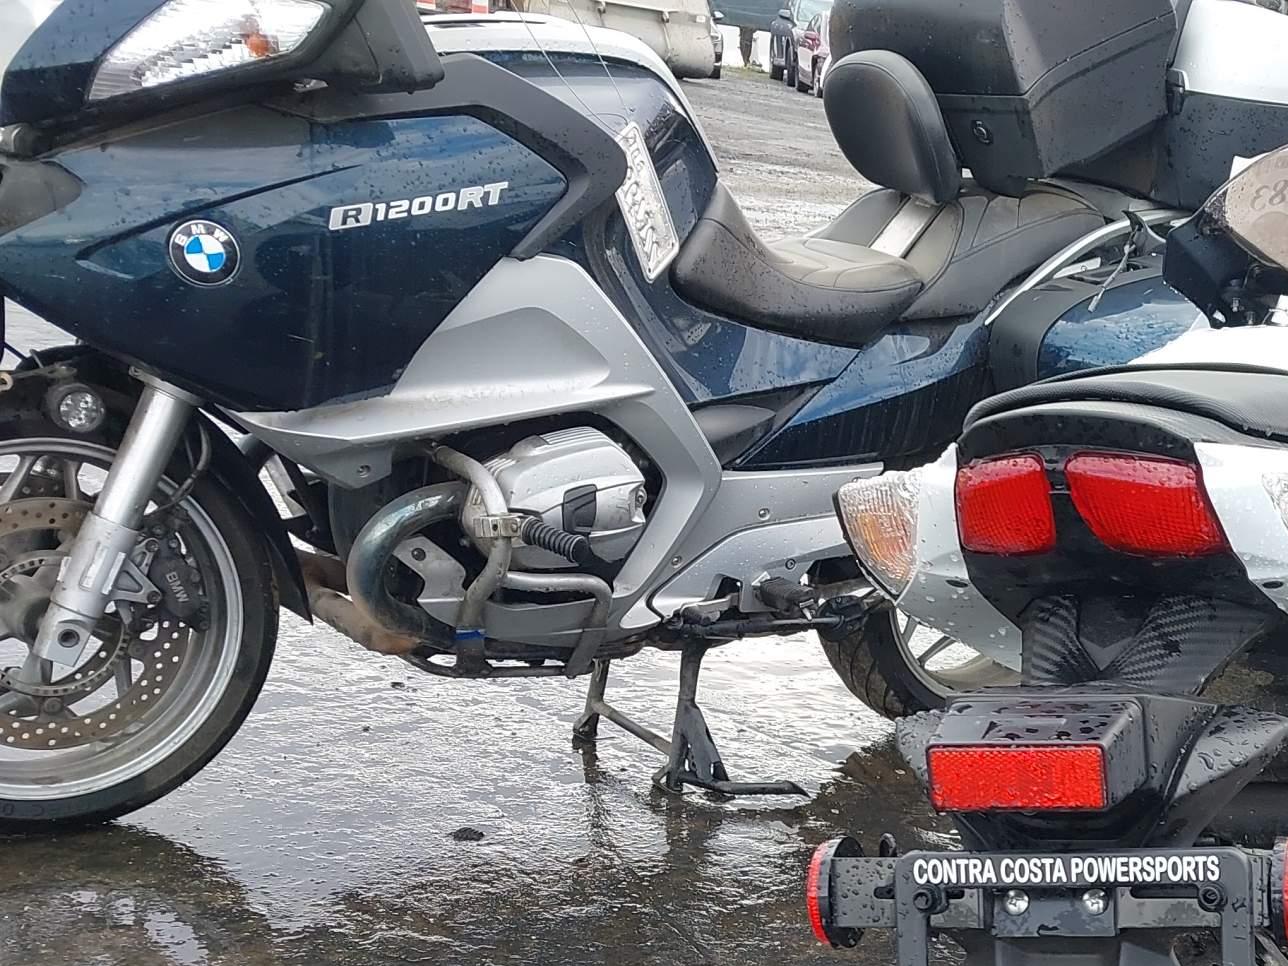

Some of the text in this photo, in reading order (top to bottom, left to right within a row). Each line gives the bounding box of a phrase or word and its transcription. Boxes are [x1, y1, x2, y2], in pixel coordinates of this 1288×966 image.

[329, 181, 509, 231] R1200RT
[174, 223, 229, 247] BMW
[165, 571, 190, 602] BMW
[913, 855, 1220, 885] CONTRA COSTA POWERSPORTS
